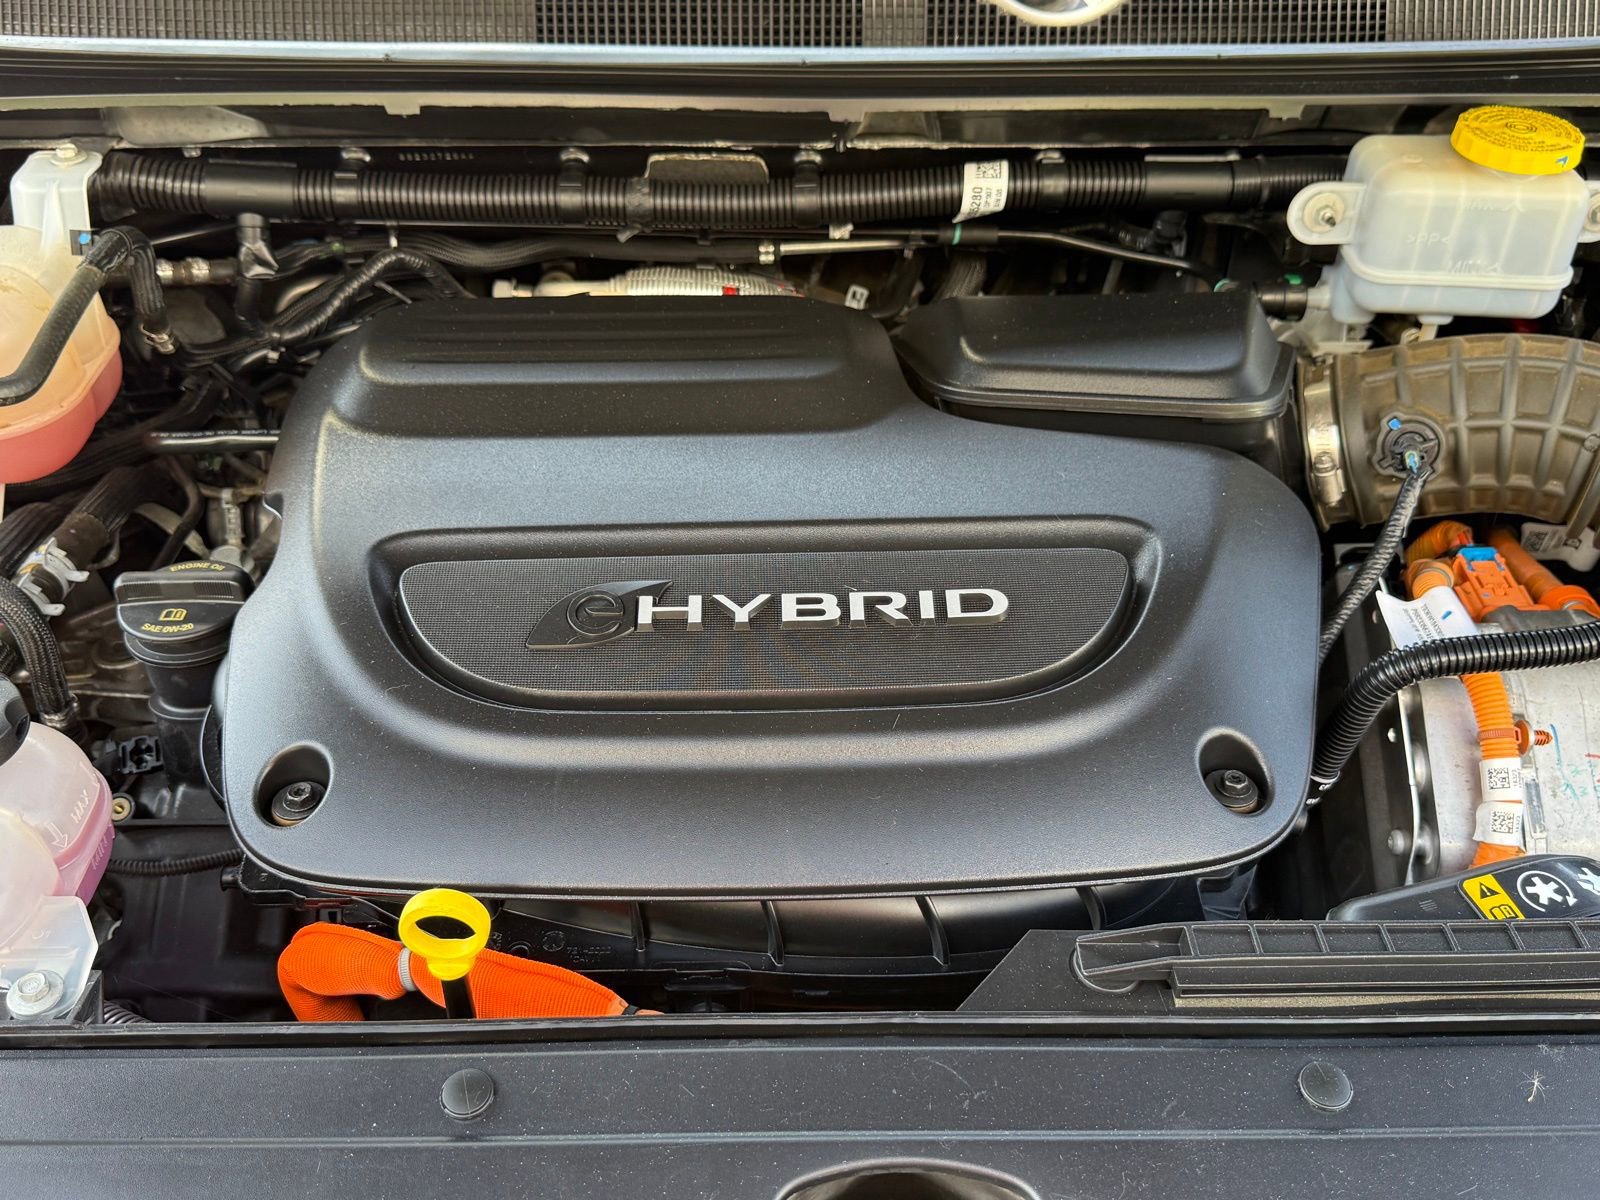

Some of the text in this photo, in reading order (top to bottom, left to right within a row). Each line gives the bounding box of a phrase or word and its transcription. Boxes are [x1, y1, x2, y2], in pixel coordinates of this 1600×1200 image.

[169, 562, 208, 573] ENGINE
[635, 588, 1010, 633] HYBRID
[141, 622, 195, 634] SAE 0W-20
